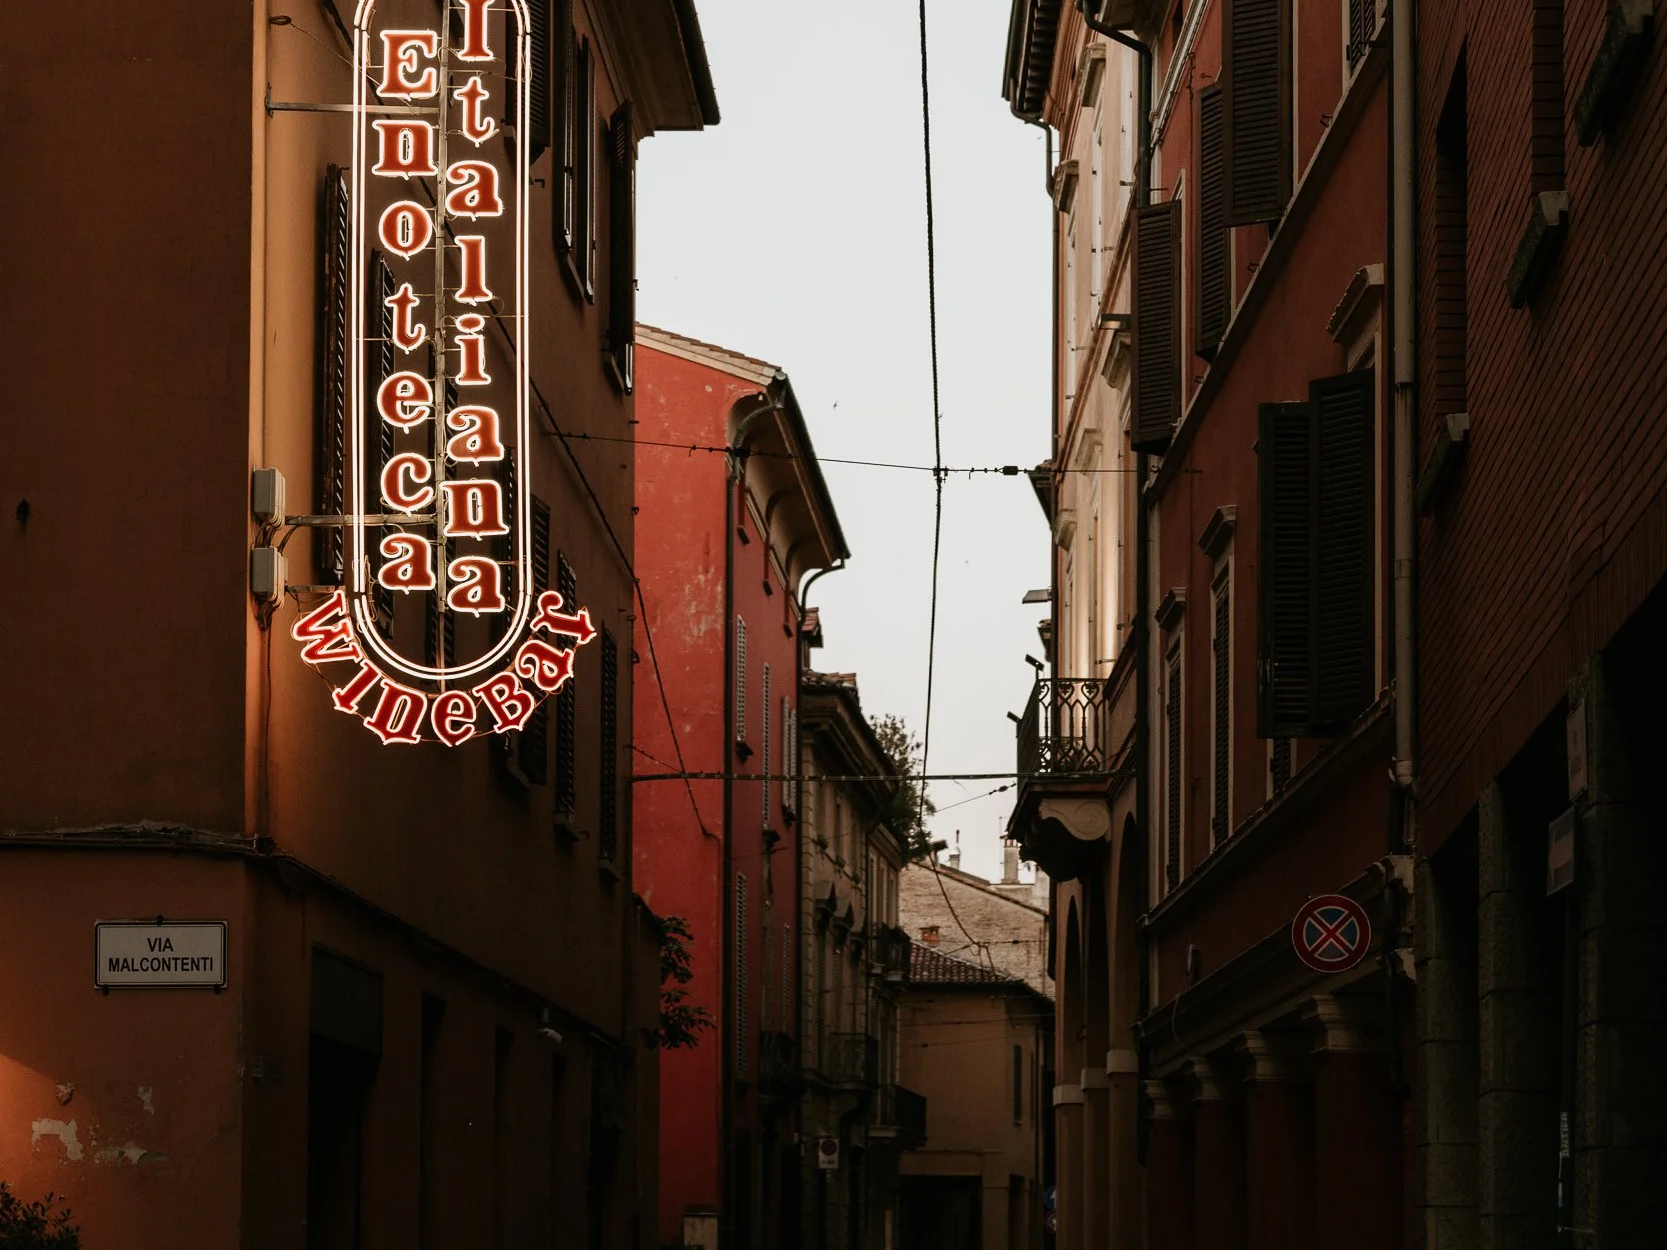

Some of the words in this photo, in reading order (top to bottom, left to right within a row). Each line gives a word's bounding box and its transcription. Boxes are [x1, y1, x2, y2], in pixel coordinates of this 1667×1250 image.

[372, 29, 438, 594] Enoteca
[147, 937, 174, 952] VIA
[108, 957, 213, 972] MALCONTENTI
